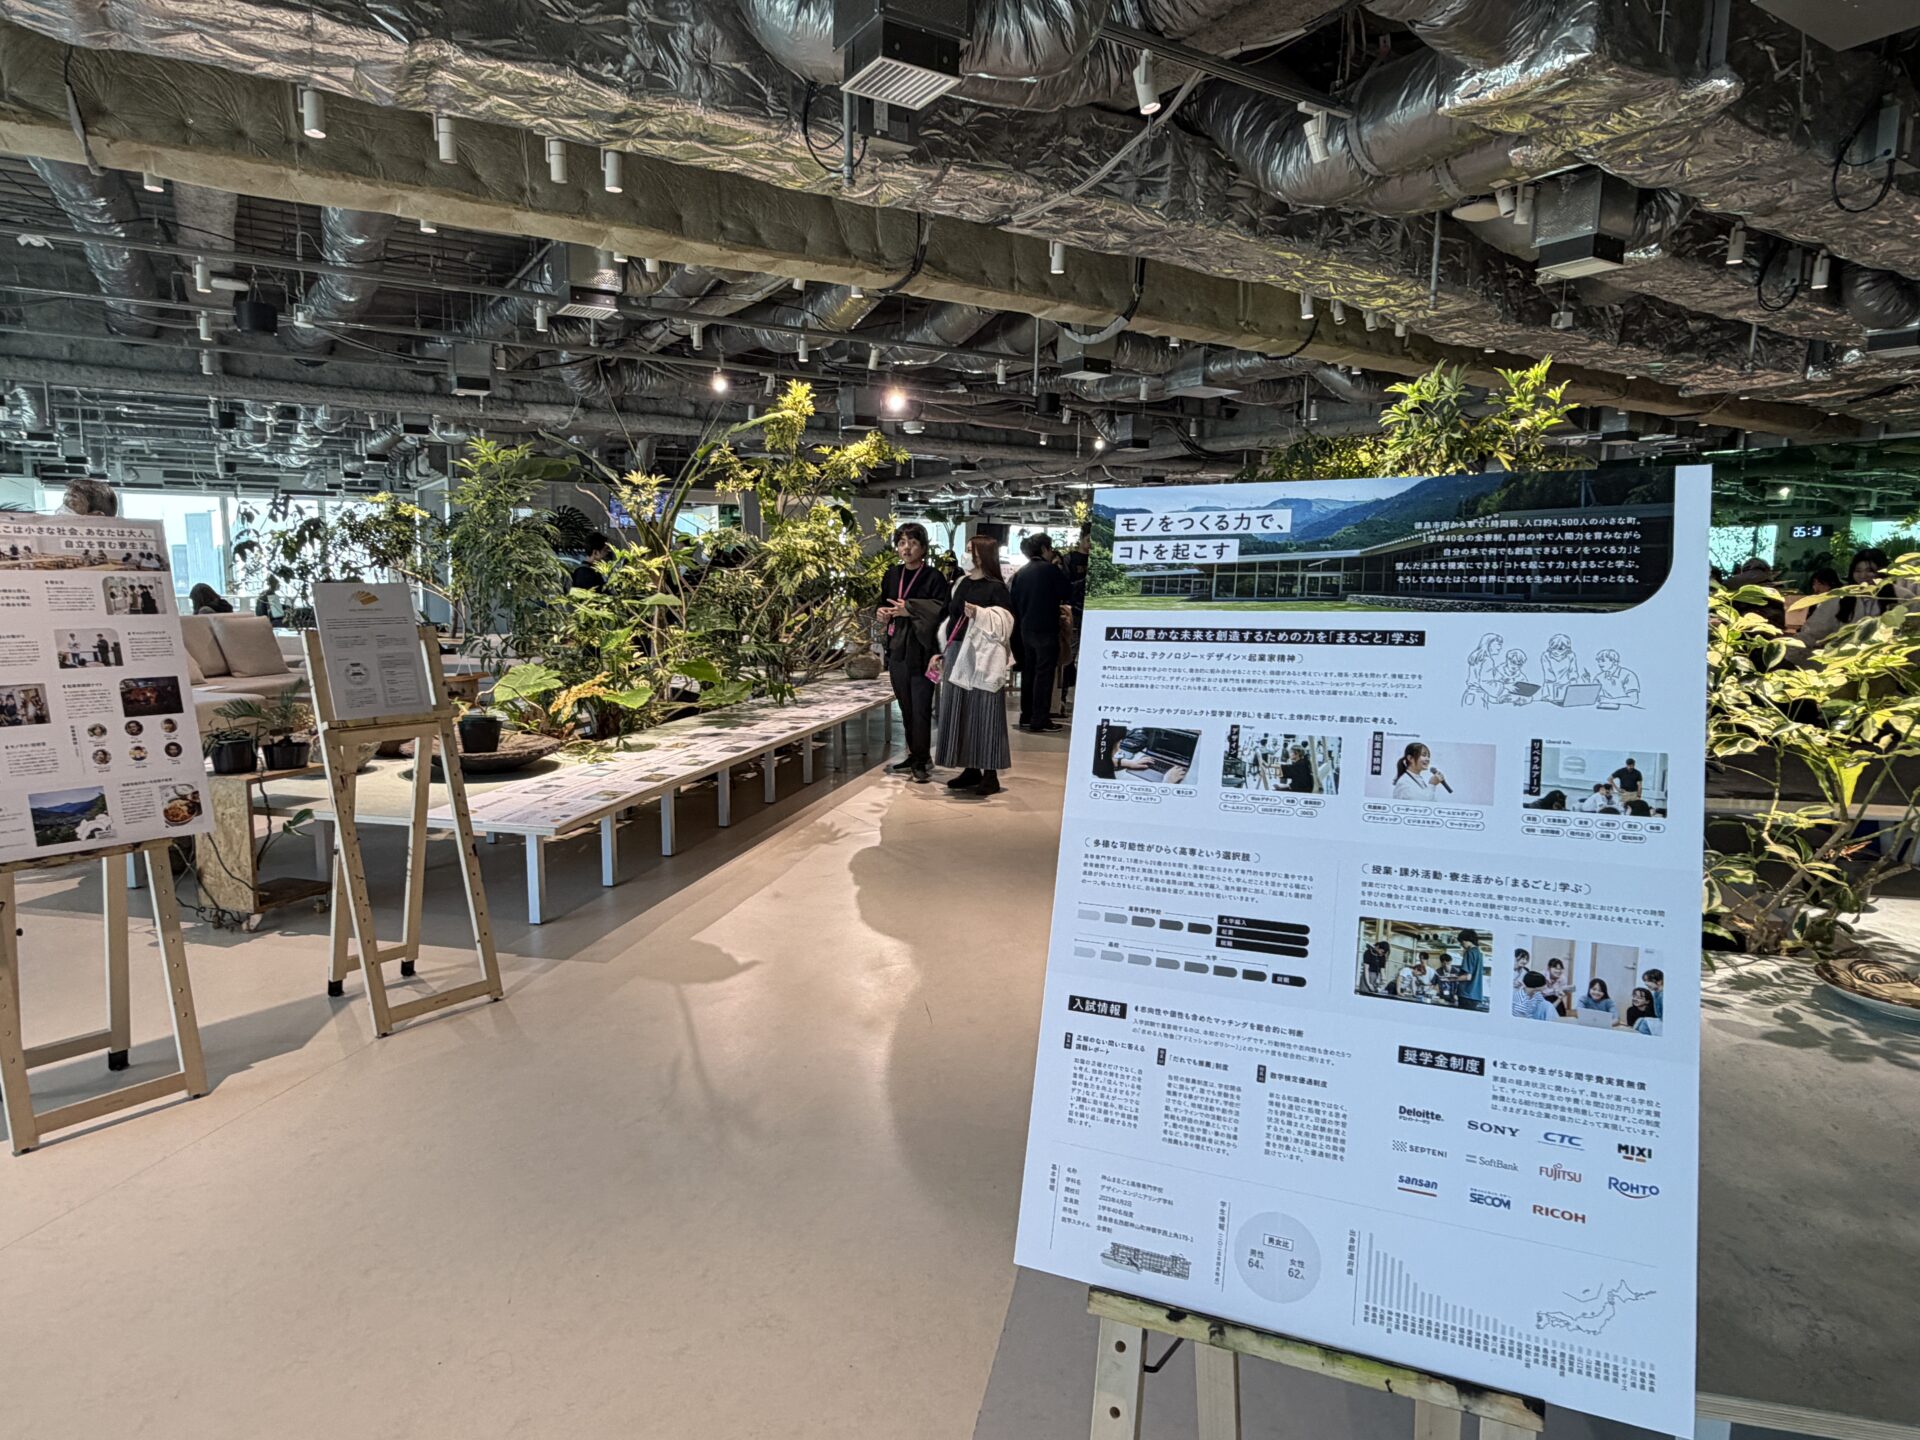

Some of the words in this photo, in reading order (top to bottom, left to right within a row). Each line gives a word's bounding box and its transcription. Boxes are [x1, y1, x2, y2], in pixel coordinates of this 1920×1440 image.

[1121, 512, 1285, 532] モノをつくる力で、
[0, 526, 153, 538] こは小さな社会、あなたは大人。
[1119, 542, 1231, 561] コトを起こす
[1110, 628, 1420, 645] 人間の豊かな未来を創造するための力を「まるごと」学ぶ
[1100, 721, 1109, 760] テクノロジー
[1230, 727, 1239, 755] デザイン
[1205, 954, 1218, 962] 大学
[1072, 997, 1122, 1018] 入試情報
[1403, 1048, 1481, 1074] 奨学金制度
[1500, 1060, 1647, 1091] 全ての学生が5年間学費実質無償
[1467, 1120, 1520, 1137] SONY
[1543, 1131, 1583, 1147] CTC
[1408, 1144, 1448, 1158] SEPTENI
[1617, 1143, 1652, 1159] MIXI
[1478, 1156, 1519, 1172] SoftBank
[1539, 1163, 1582, 1183] FUJITSU
[1469, 1192, 1511, 1210] SECOM
[1532, 1204, 1587, 1224] RICOH
[1267, 1236, 1290, 1249] 男女比
[1249, 1248, 1265, 1260] 男性
[1289, 1258, 1305, 1269] 女性
